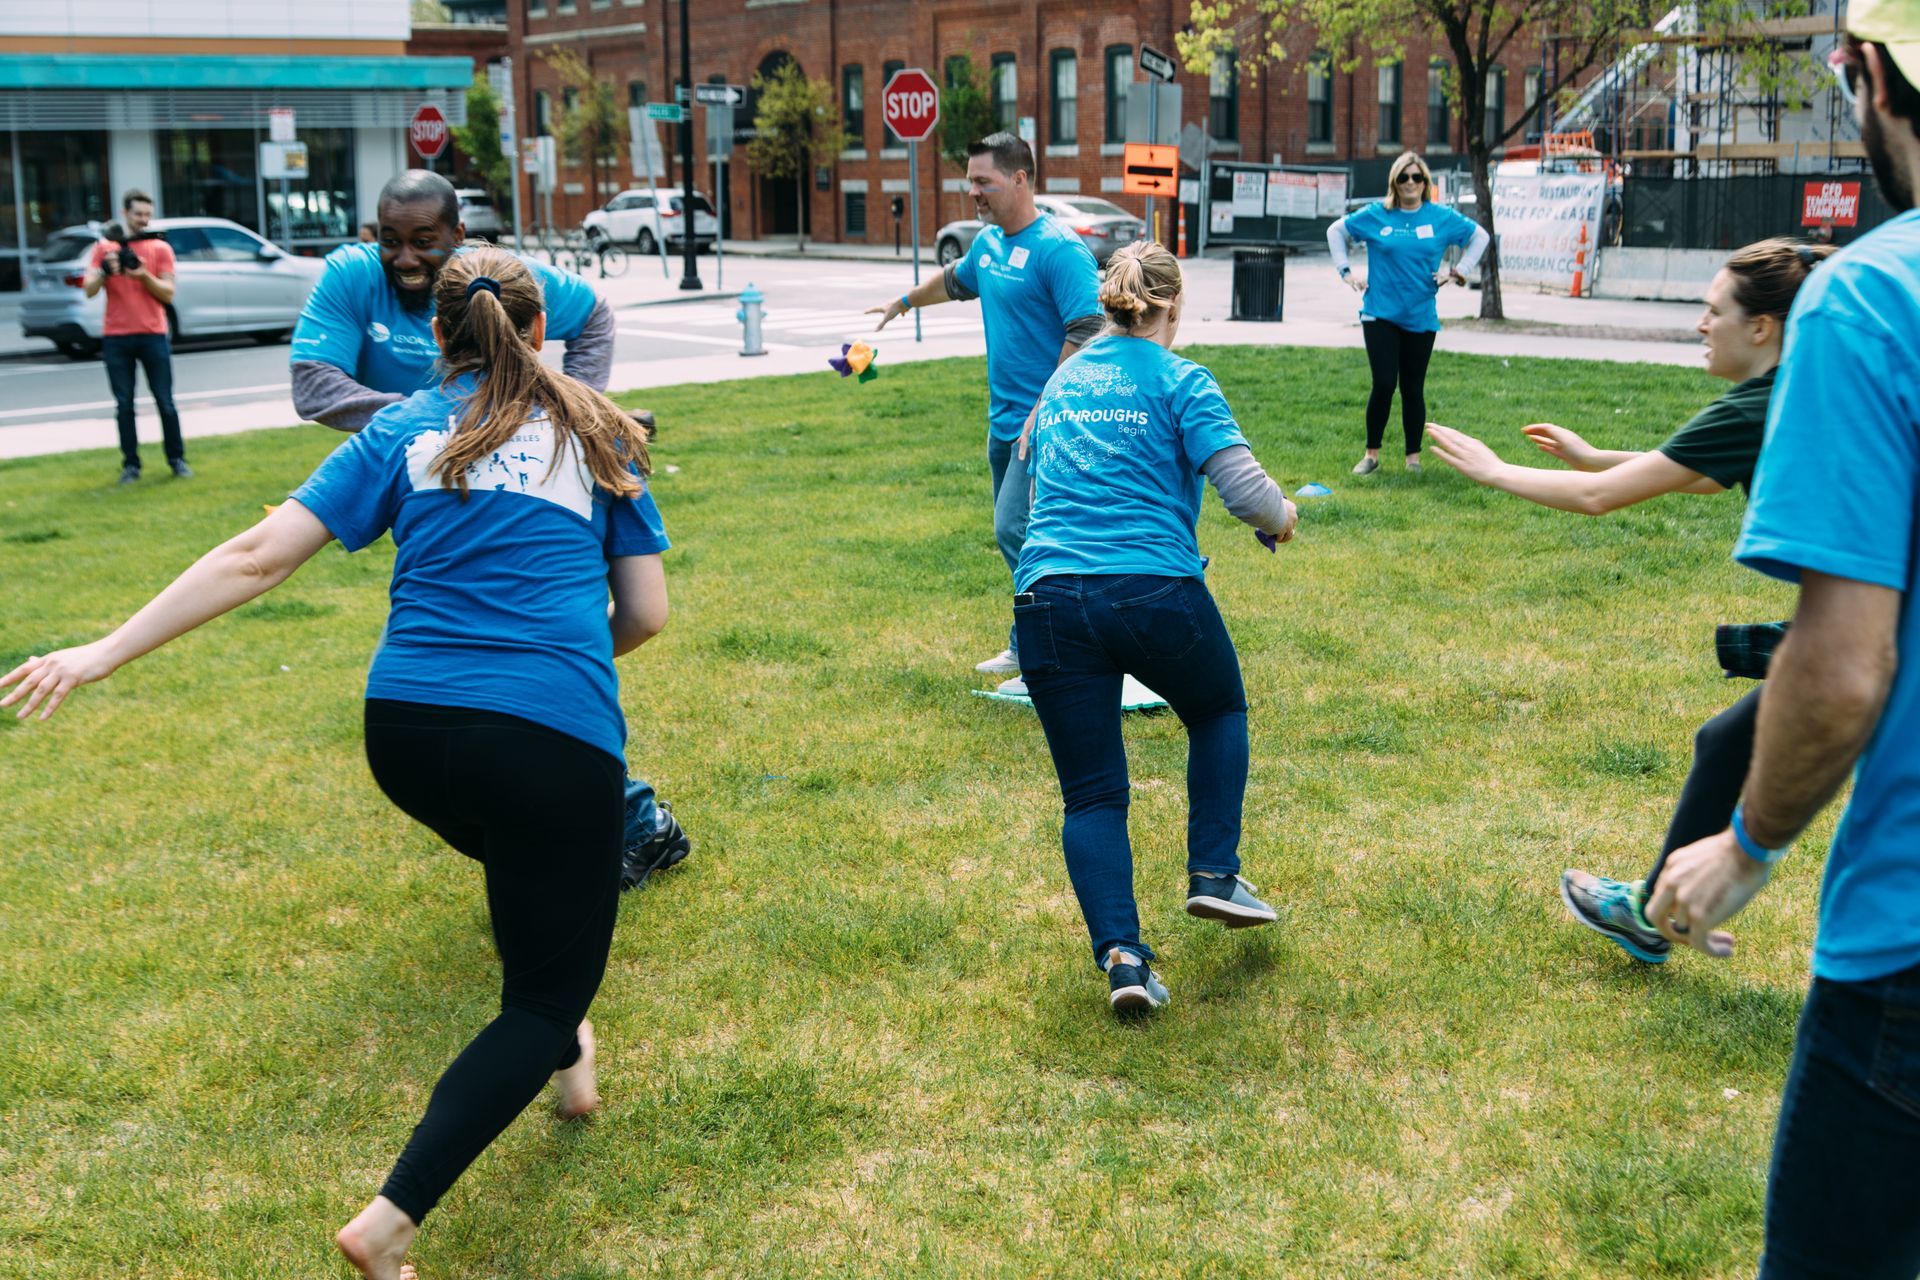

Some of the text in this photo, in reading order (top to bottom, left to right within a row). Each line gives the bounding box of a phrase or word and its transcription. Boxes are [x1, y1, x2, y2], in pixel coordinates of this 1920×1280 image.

[888, 91, 934, 119] STOP
[413, 120, 442, 141] STOP
[1806, 195, 1856, 208] TEMPORARY
[1805, 206, 1854, 218] STAND PIPE
[1038, 408, 1149, 431] EAKTHROUGHS
[1117, 424, 1147, 437] Begin
